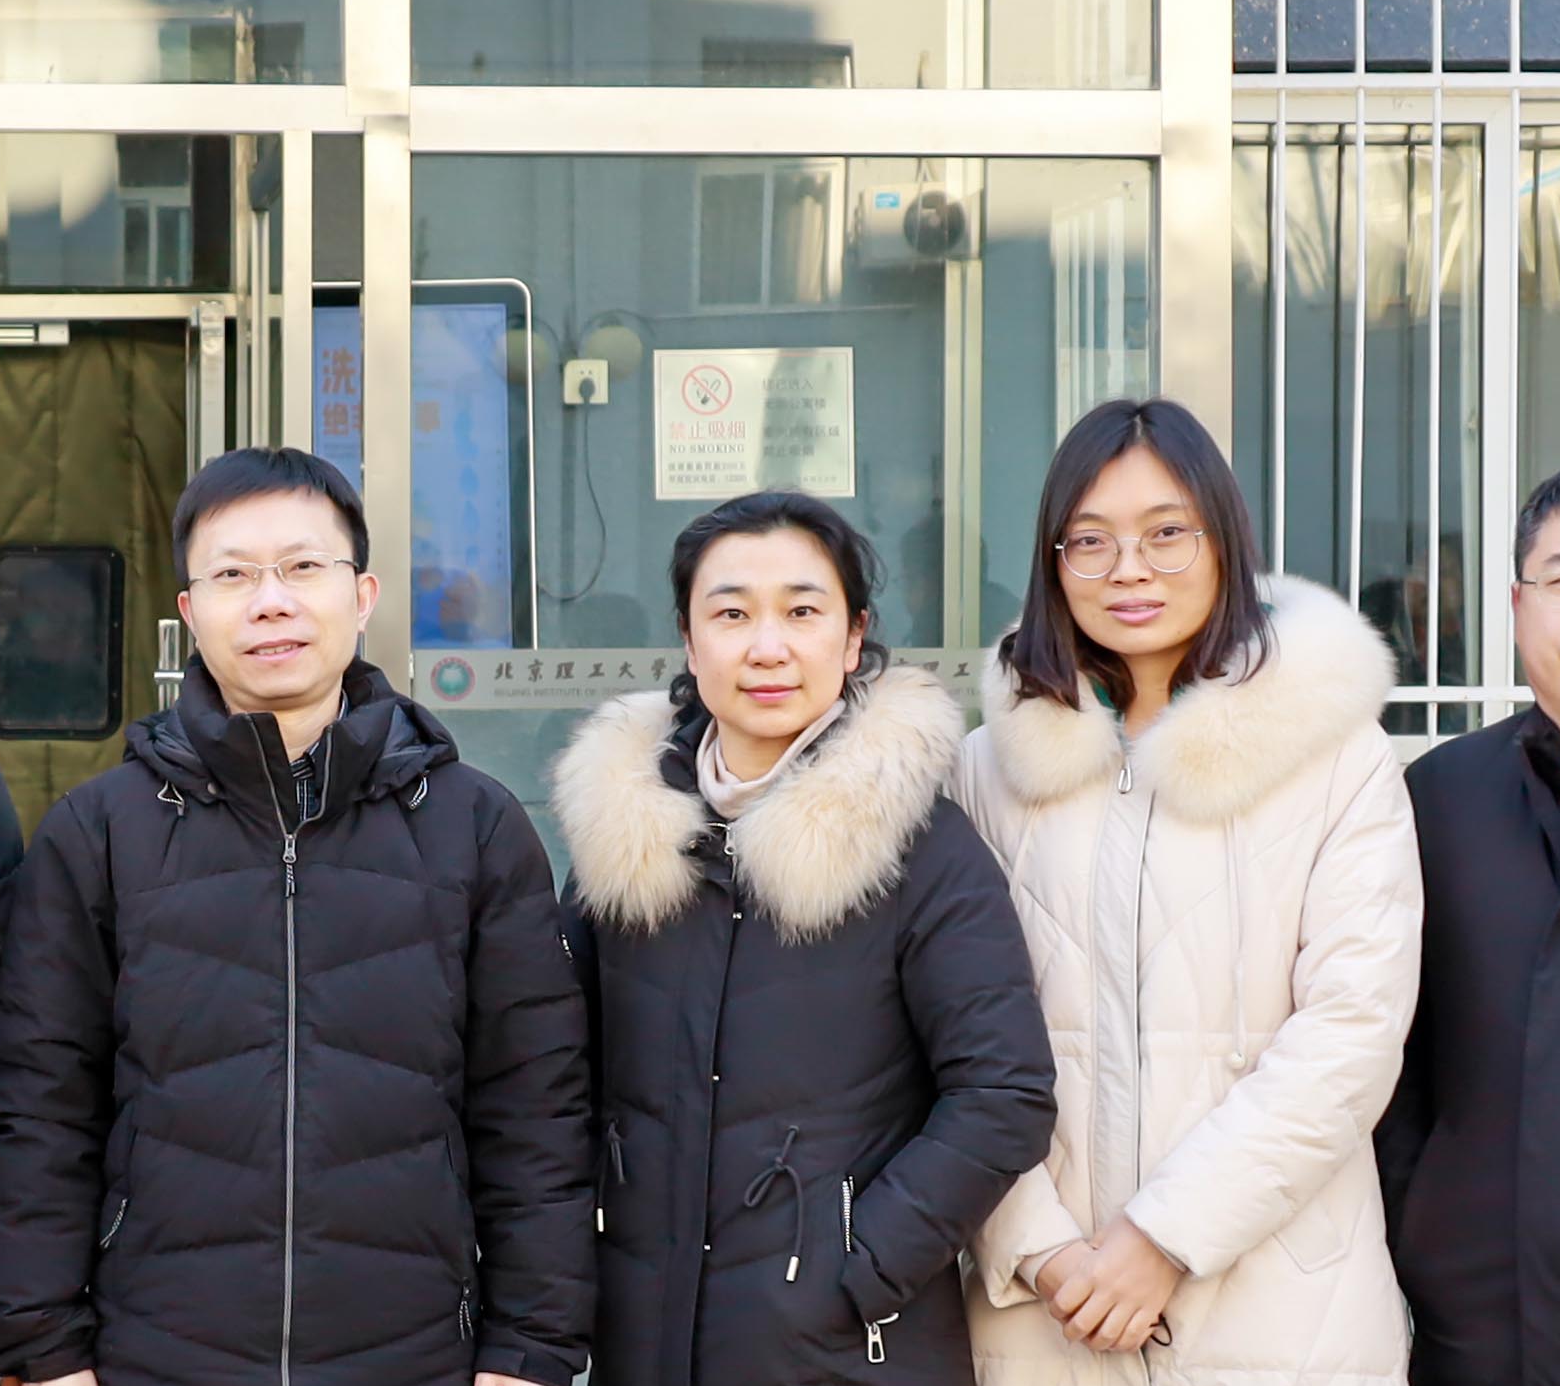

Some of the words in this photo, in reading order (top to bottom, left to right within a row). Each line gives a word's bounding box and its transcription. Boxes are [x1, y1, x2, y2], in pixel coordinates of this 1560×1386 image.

[671, 420, 746, 440] 禁止吸烟
[669, 444, 686, 454] NO
[690, 444, 745, 454] SMOKING
